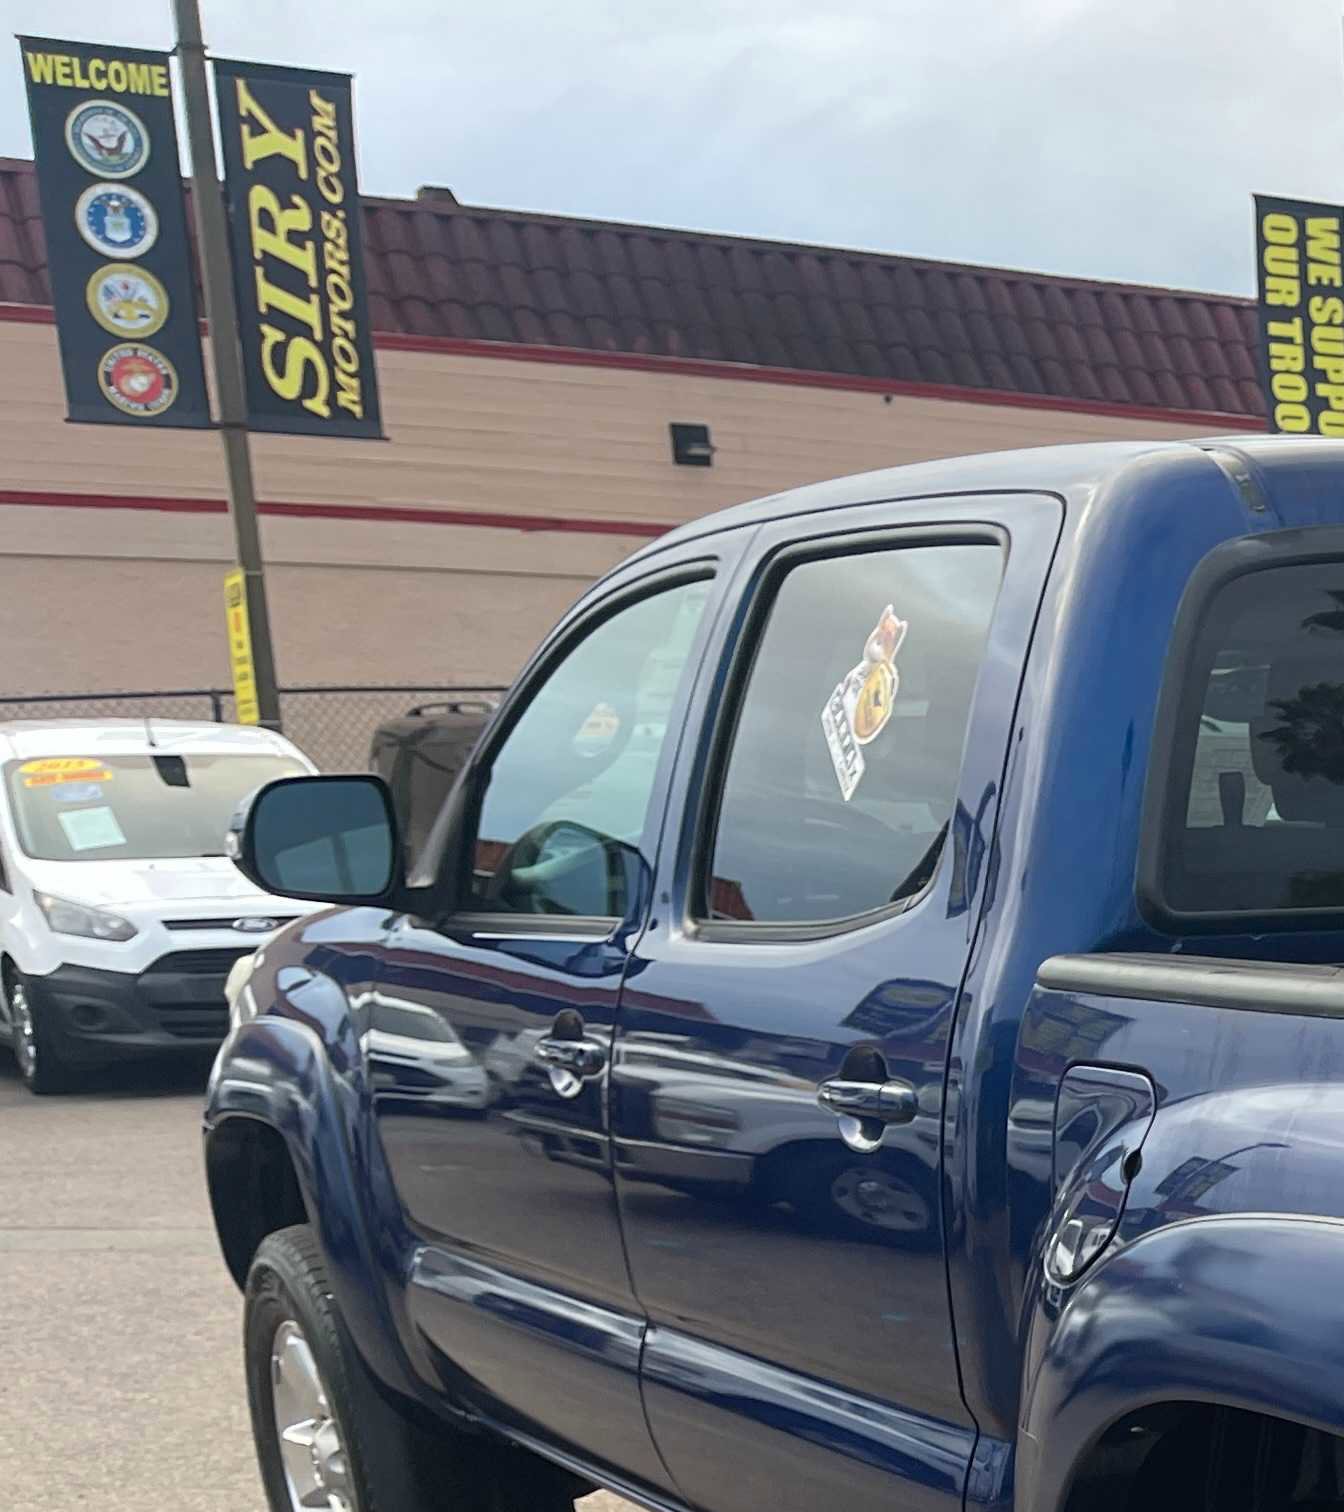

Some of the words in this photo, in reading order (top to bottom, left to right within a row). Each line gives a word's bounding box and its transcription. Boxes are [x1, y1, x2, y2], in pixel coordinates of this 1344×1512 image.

[26, 52, 169, 97] WELCOME
[236, 78, 331, 419] SIRY
[1262, 213, 1301, 307] OUR
[1305, 217, 1343, 287] WE
